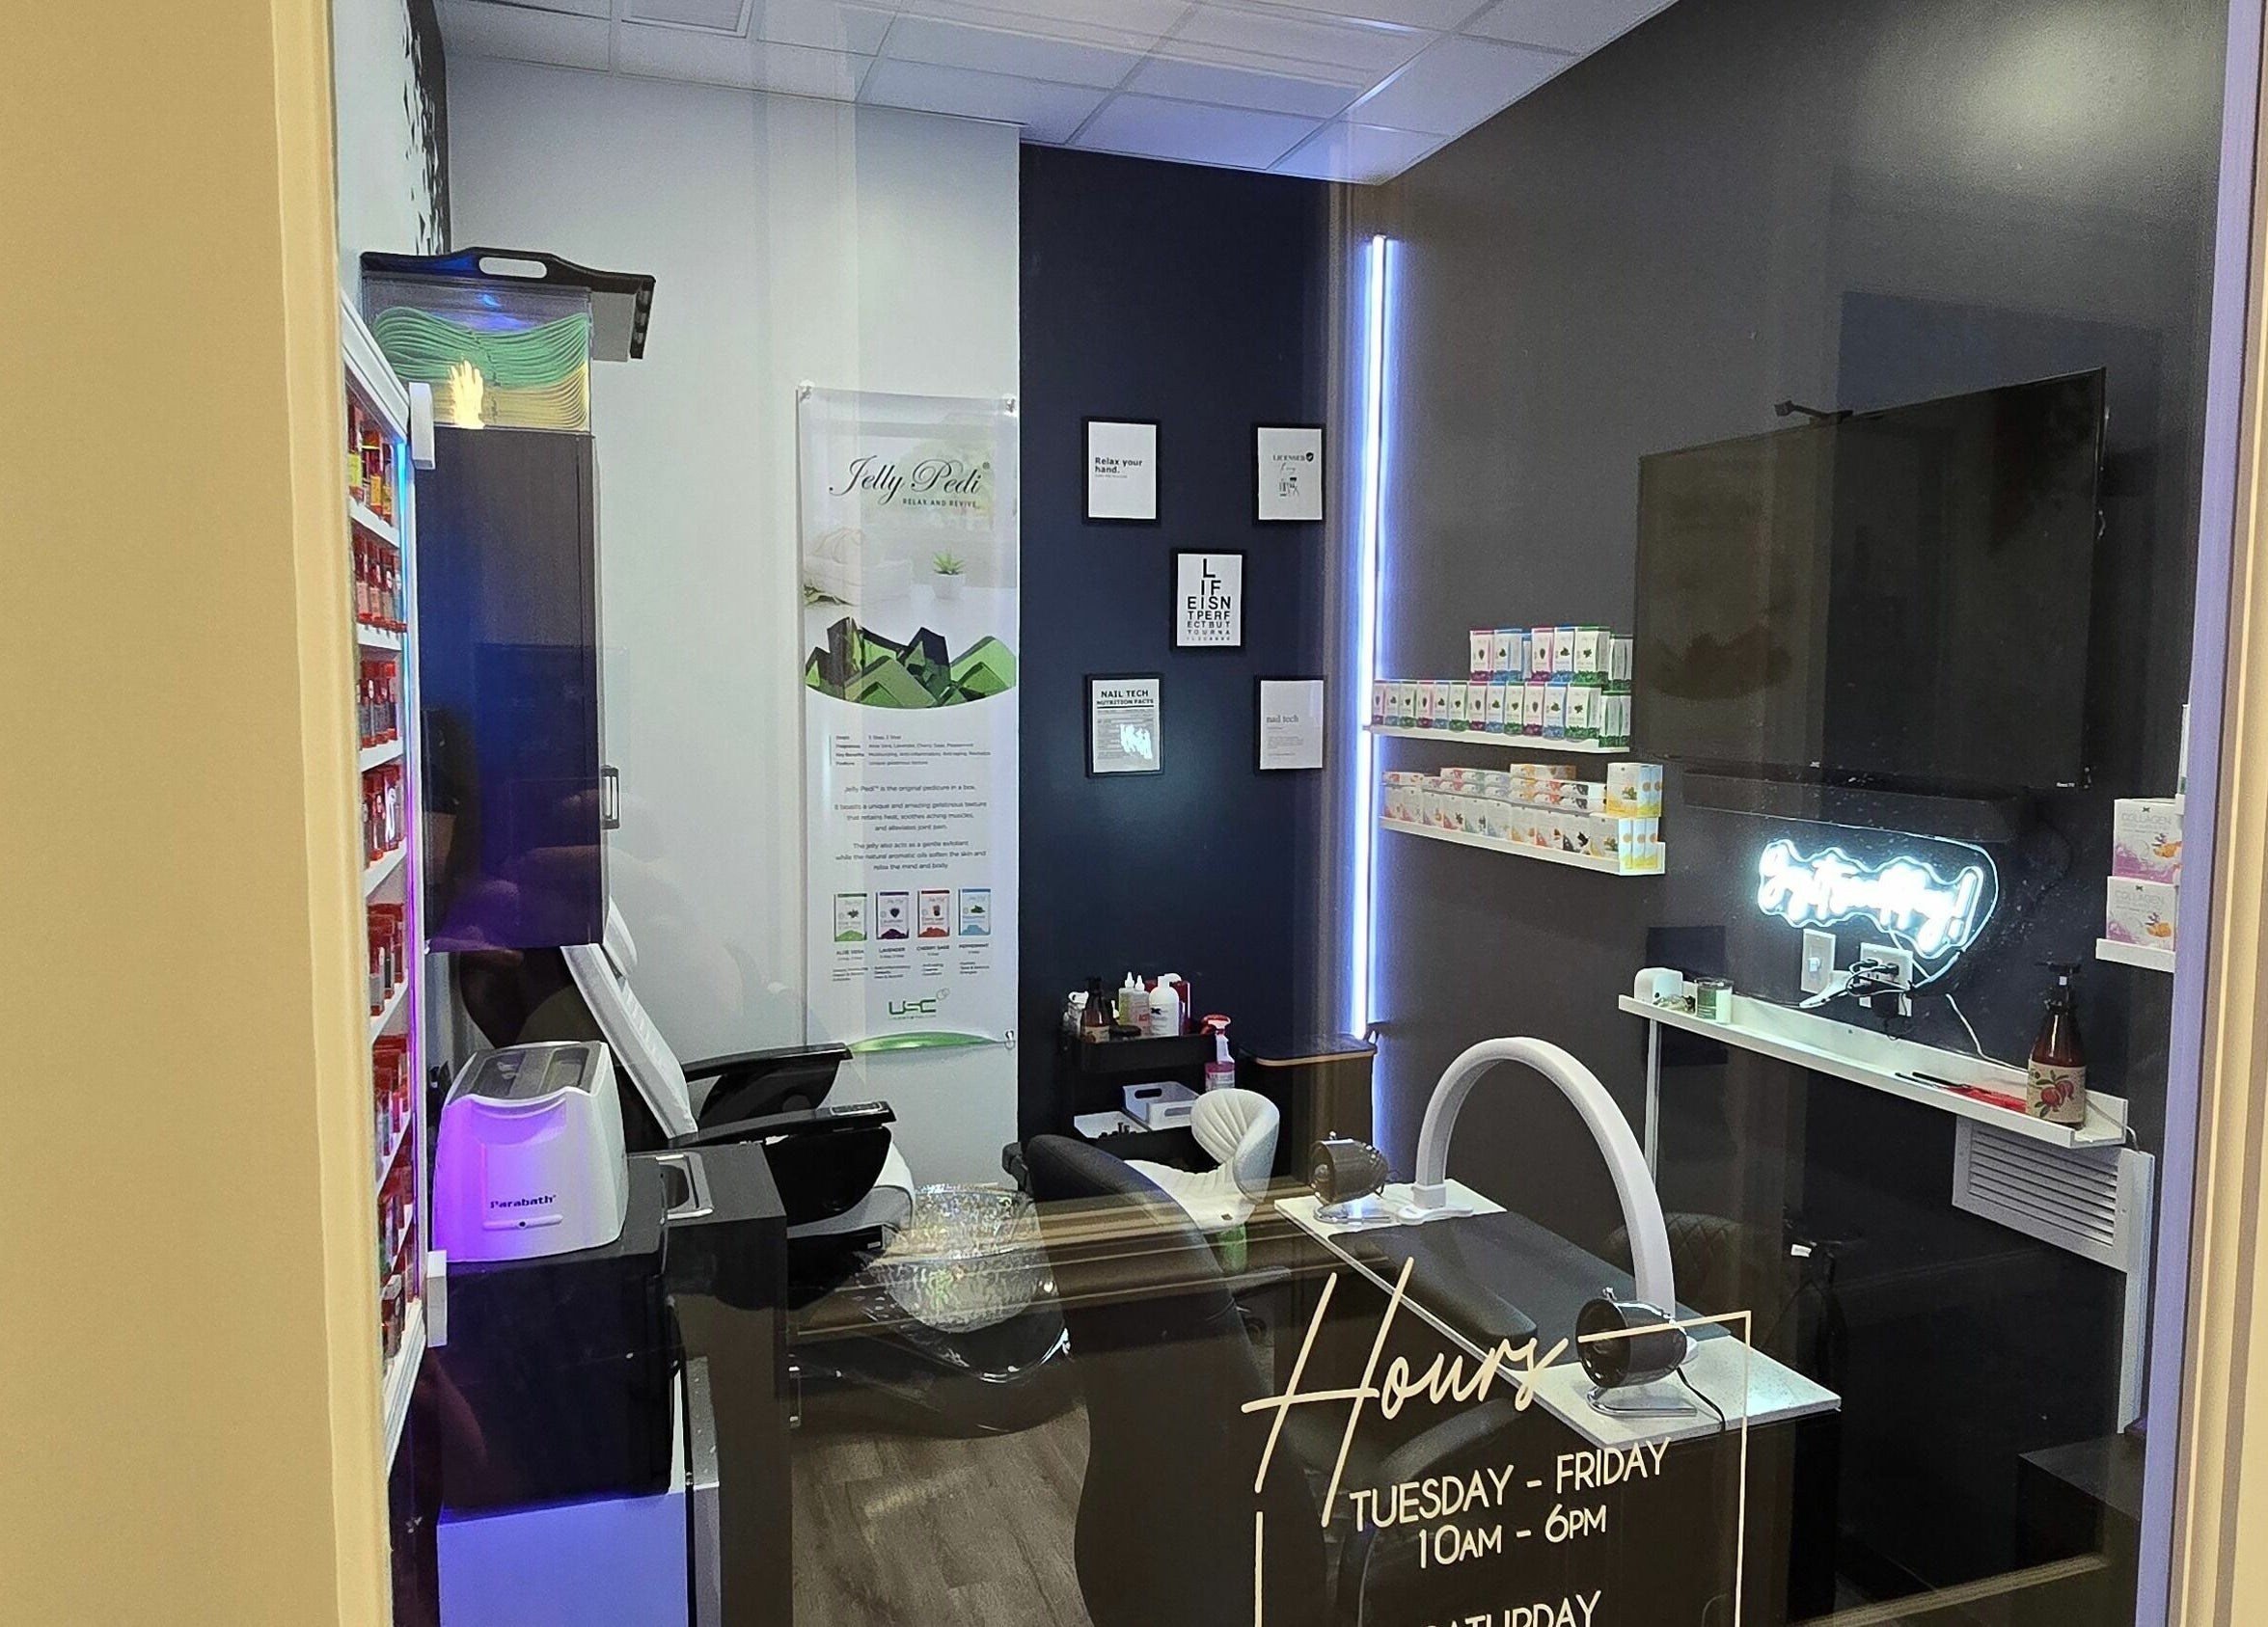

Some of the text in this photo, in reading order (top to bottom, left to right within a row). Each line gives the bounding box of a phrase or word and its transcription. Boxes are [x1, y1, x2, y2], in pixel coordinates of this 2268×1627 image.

[1095, 456, 1119, 465] Relax
[1095, 465, 1120, 474] hand.
[829, 454, 904, 505] Jelly
[903, 498, 927, 506] RELAX
[1203, 558, 1216, 578] L
[1201, 580, 1221, 596] IF
[1101, 689, 1149, 698] NAIL TECH
[1266, 715, 1299, 723] nail tech
[888, 998, 937, 1015] USC
[490, 1195, 553, 1208] Parabath
[1242, 1256, 1569, 1529] Hours
[1350, 1463, 1515, 1532] TUESDAY
[1556, 1436, 1672, 1494] FRIDAY
[1418, 1524, 1502, 1570] 10AM
[1544, 1504, 1607, 1545] 6PM
